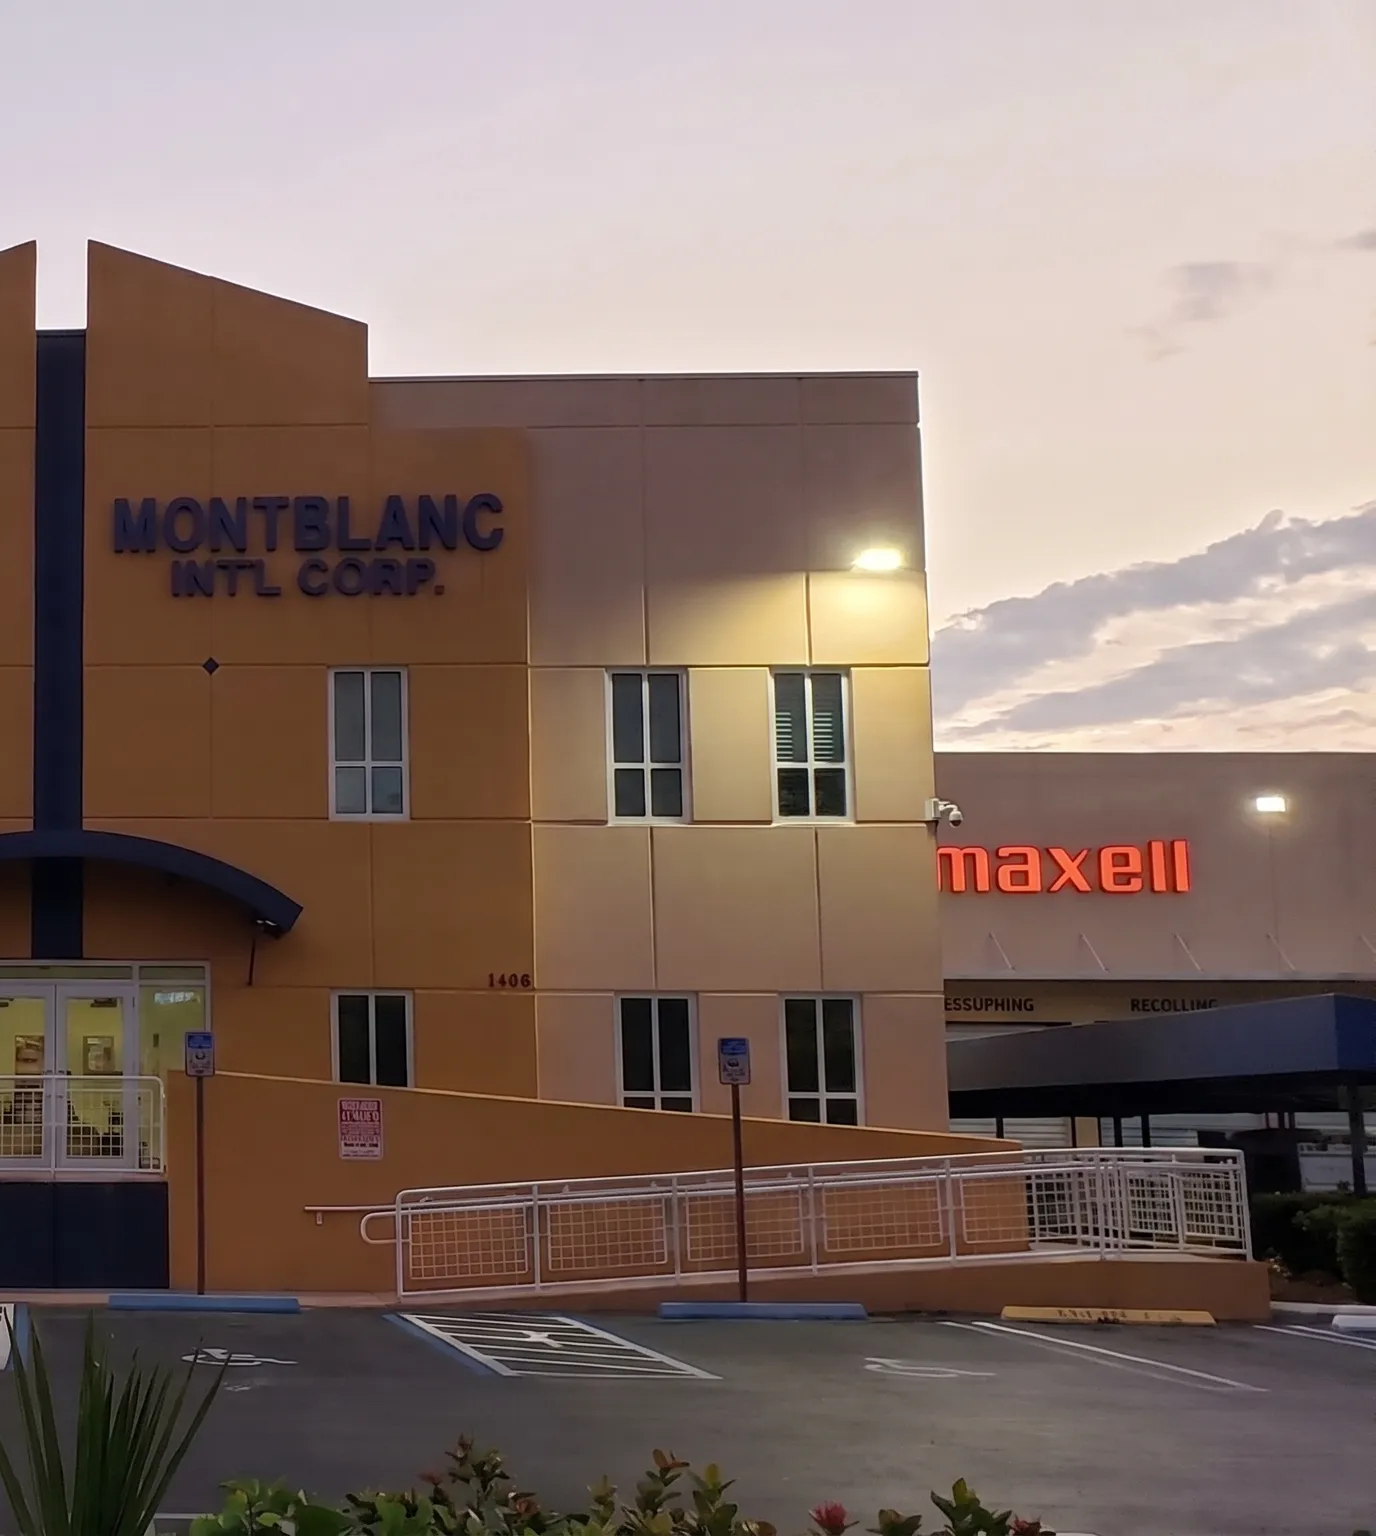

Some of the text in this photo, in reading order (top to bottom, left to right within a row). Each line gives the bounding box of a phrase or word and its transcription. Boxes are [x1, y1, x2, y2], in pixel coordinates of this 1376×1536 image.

[113, 494, 504, 553] MONTBLANC
[297, 556, 445, 597] CORP.
[936, 839, 1191, 893] maxell
[488, 973, 532, 988] 1406
